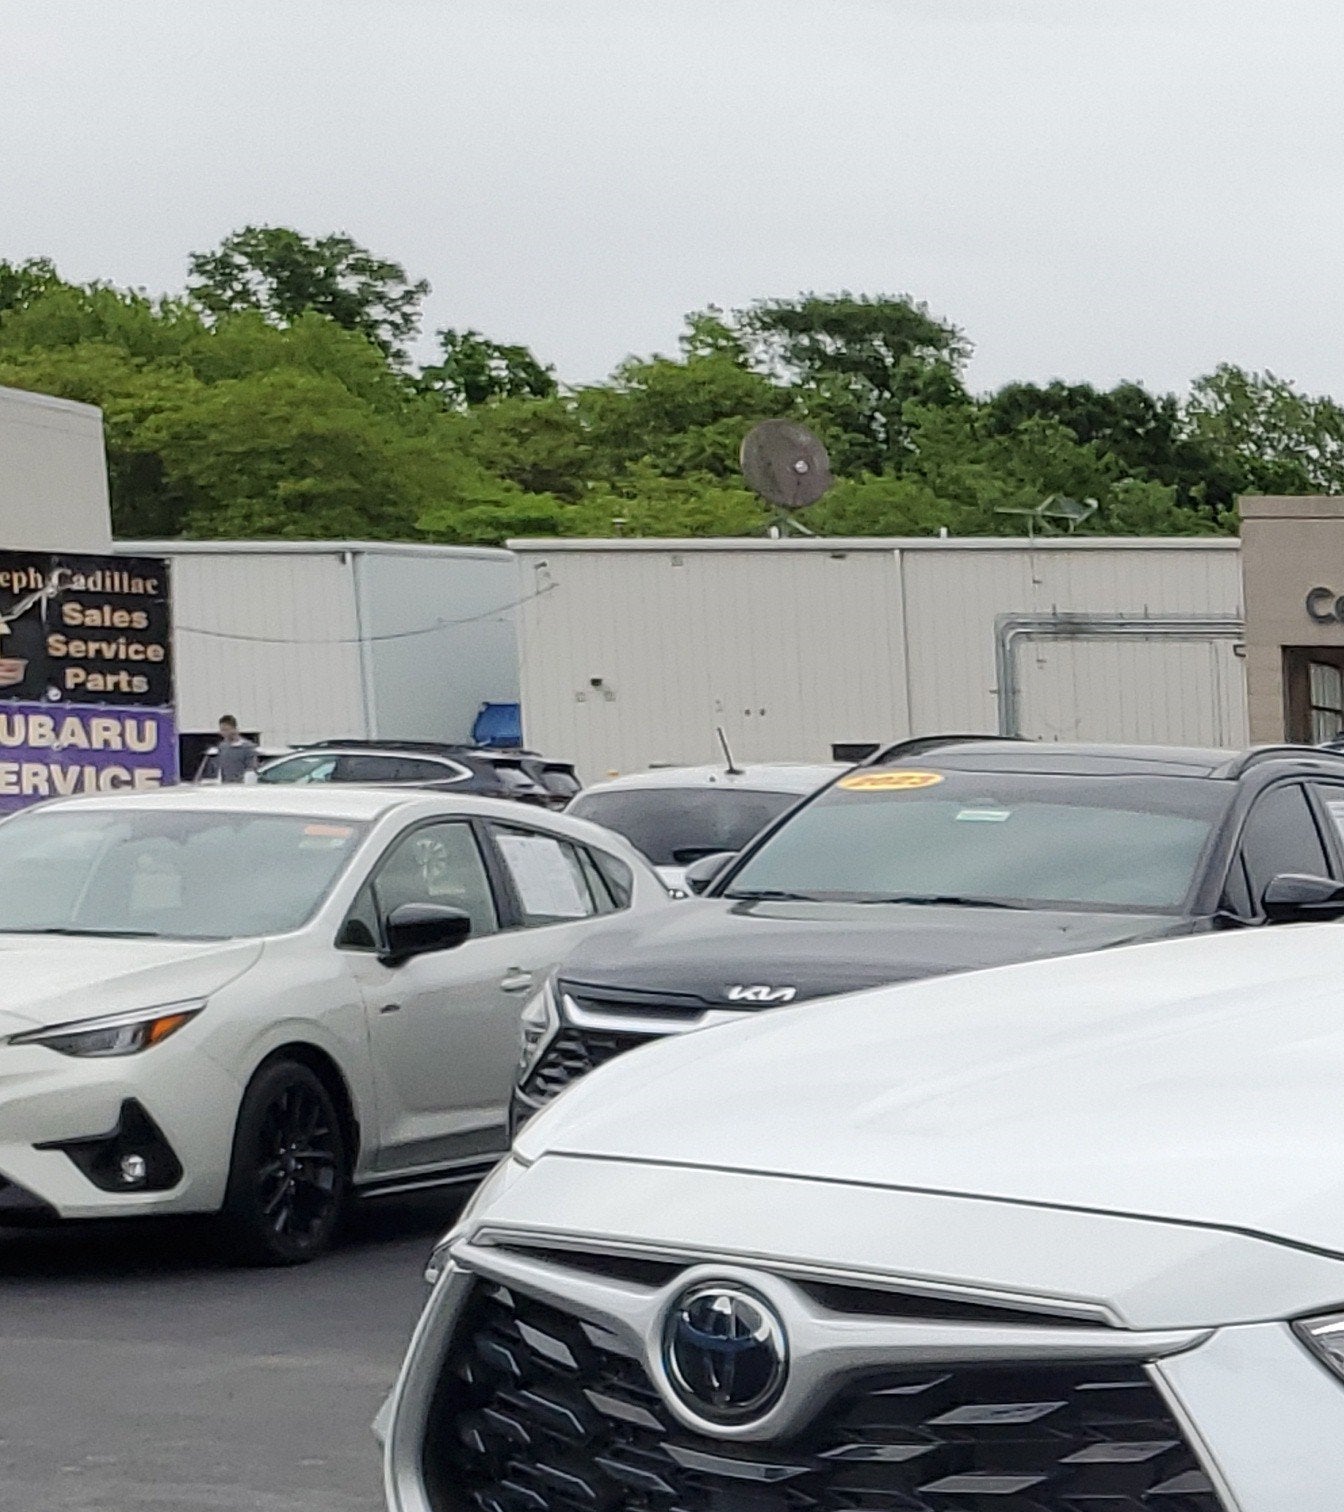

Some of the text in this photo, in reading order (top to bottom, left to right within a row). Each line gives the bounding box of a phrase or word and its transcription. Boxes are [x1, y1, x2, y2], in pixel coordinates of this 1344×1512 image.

[50, 567, 159, 595] Cadillac
[62, 602, 149, 629] Sales
[47, 633, 165, 662] Service
[64, 666, 149, 693] Parts
[0, 714, 158, 752] UBARU
